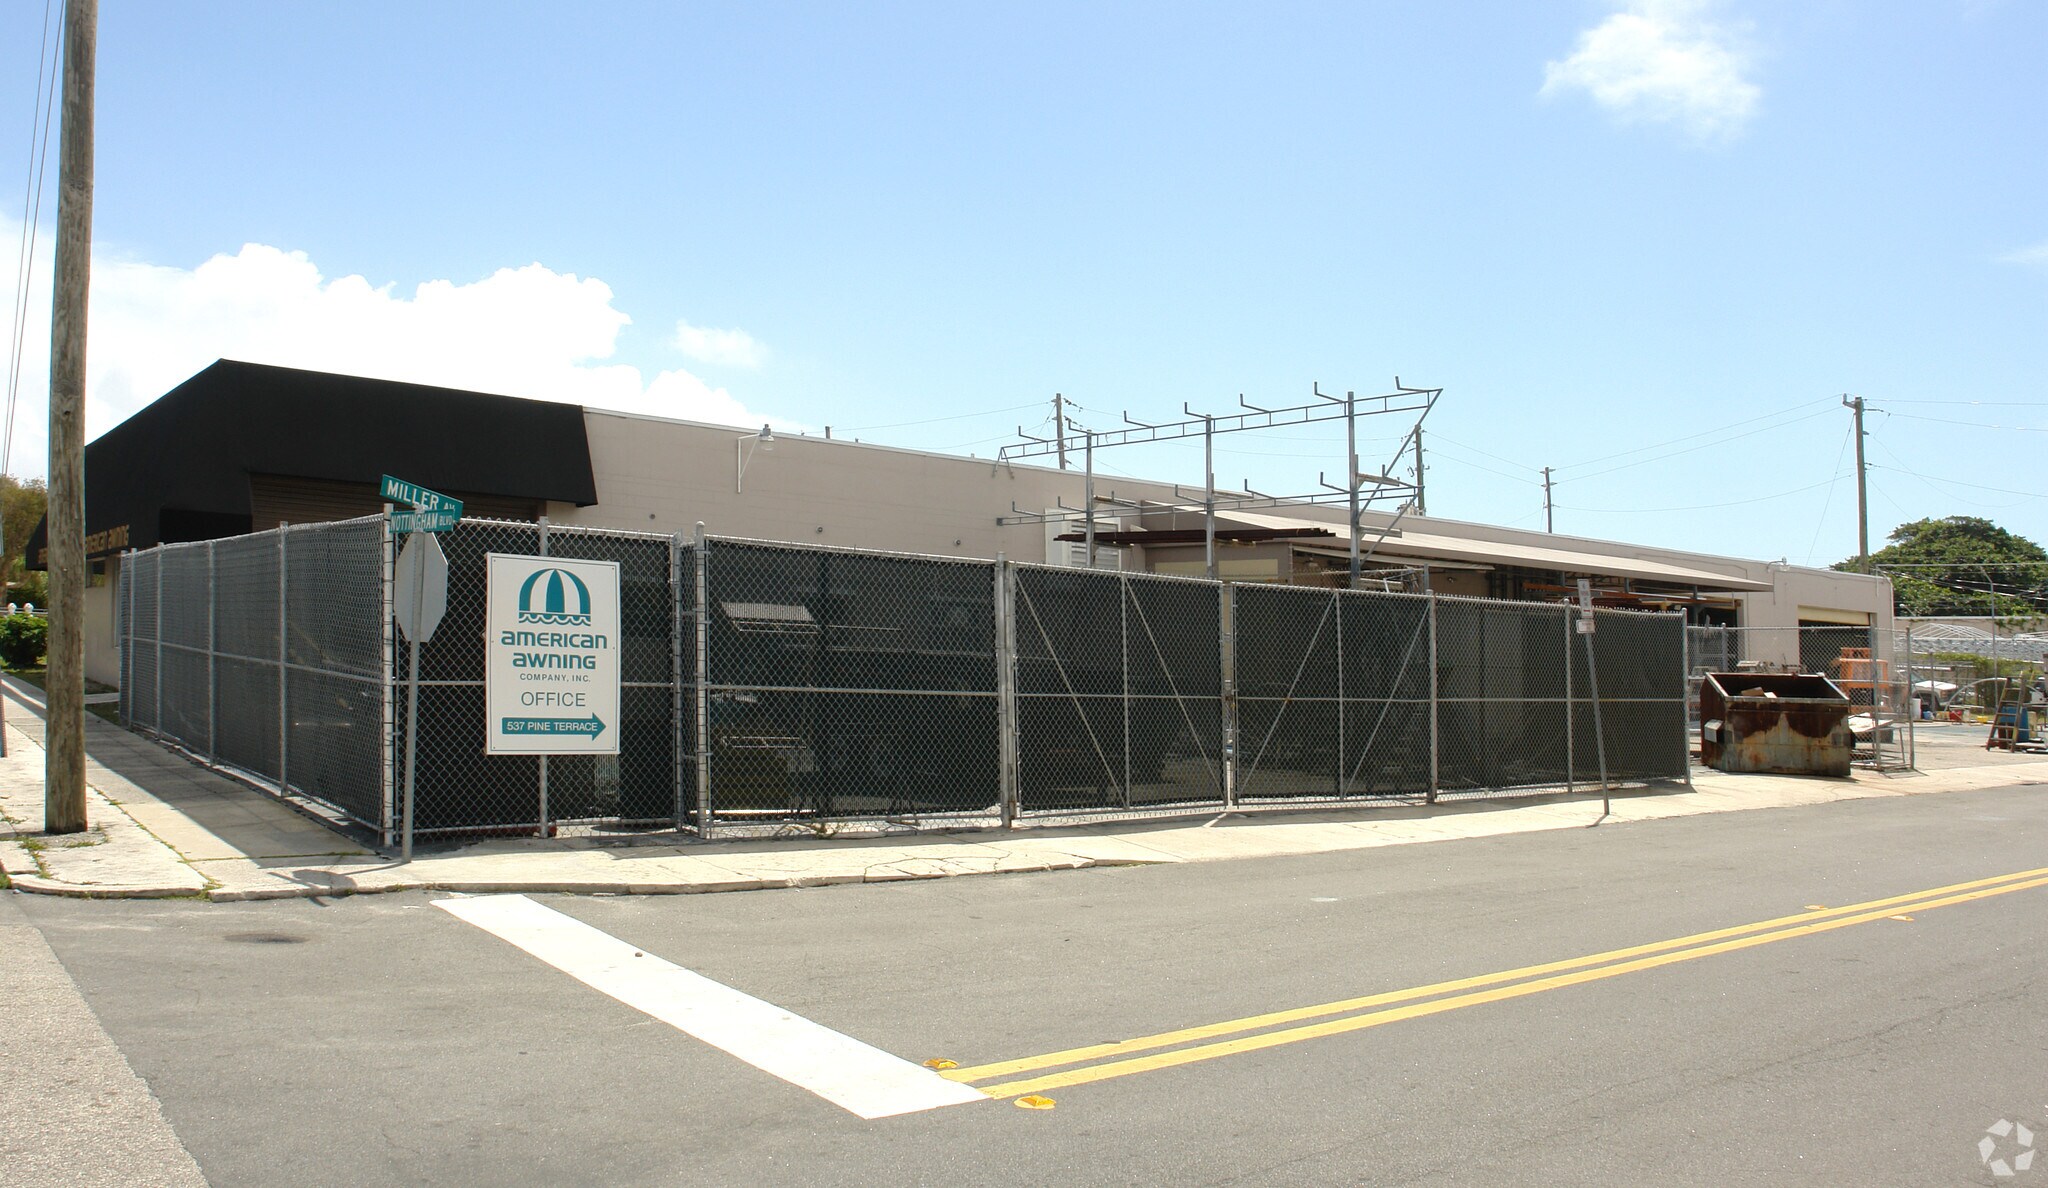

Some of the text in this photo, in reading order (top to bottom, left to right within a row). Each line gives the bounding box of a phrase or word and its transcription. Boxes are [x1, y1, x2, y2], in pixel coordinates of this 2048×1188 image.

[387, 480, 439, 510] MILLER
[390, 513, 438, 531] NOTTINGHAM
[520, 673, 570, 682] COMPANY,
[521, 691, 586, 707] OFFICE
[507, 722, 598, 731] 537 PINE TERRACE
